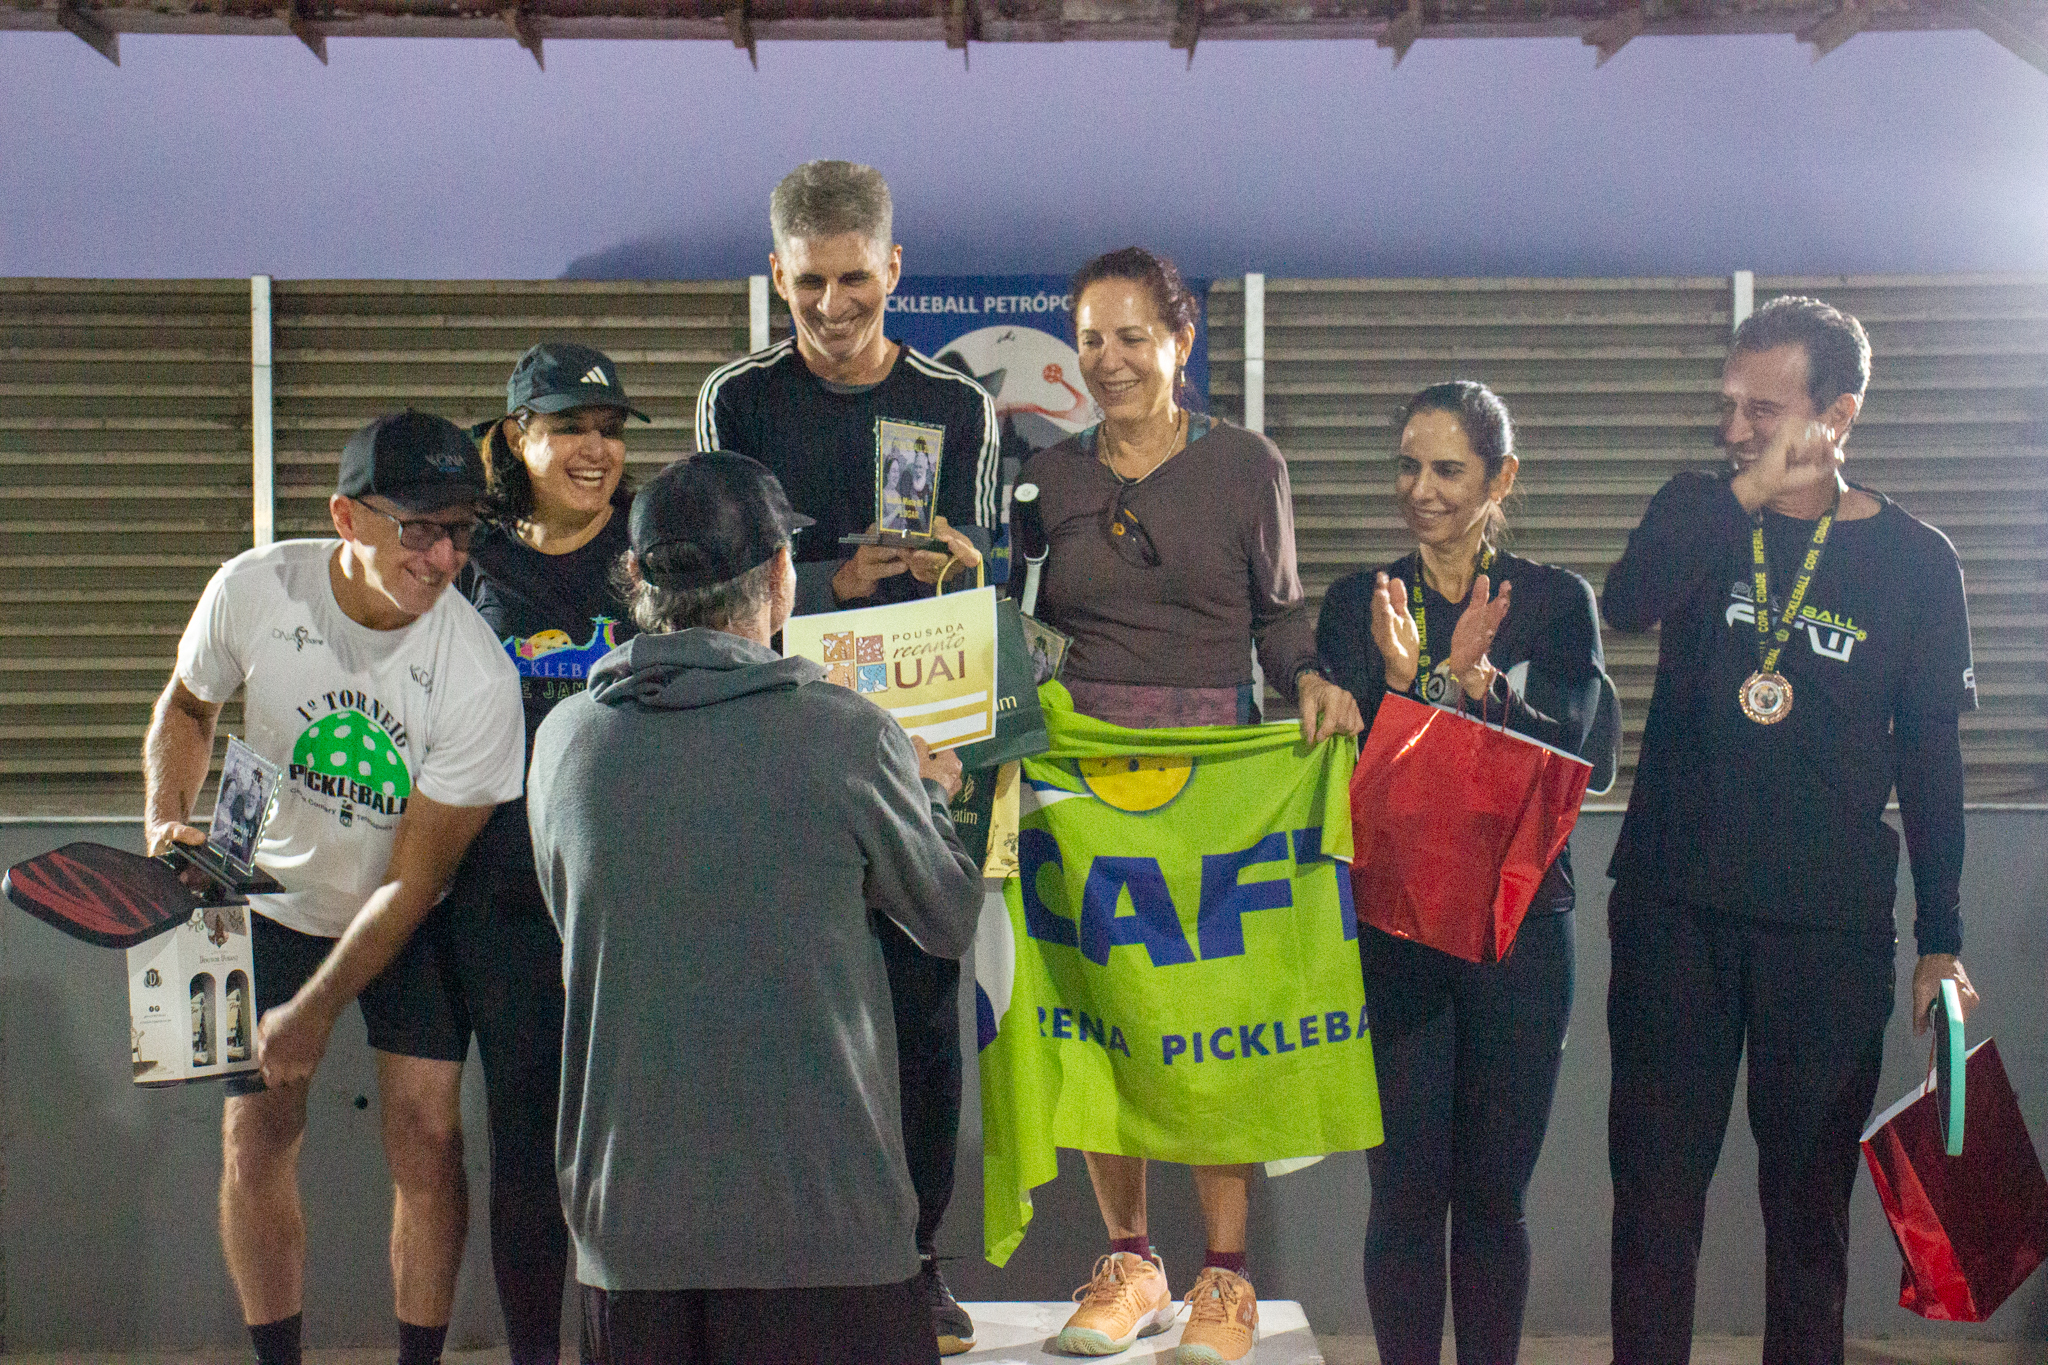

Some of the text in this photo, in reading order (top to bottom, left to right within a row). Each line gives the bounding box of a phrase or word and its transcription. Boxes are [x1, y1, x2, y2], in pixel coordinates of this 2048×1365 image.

[1803, 549, 1820, 571] COPA
[1755, 572, 1767, 603] CIDADE
[1782, 575, 1811, 624] PICKLEBALL
[1758, 609, 1769, 633] COPA
[1802, 604, 1858, 631] BALL
[892, 623, 964, 642] POUSADA
[893, 632, 965, 659] recanto
[894, 650, 966, 690] UAI
